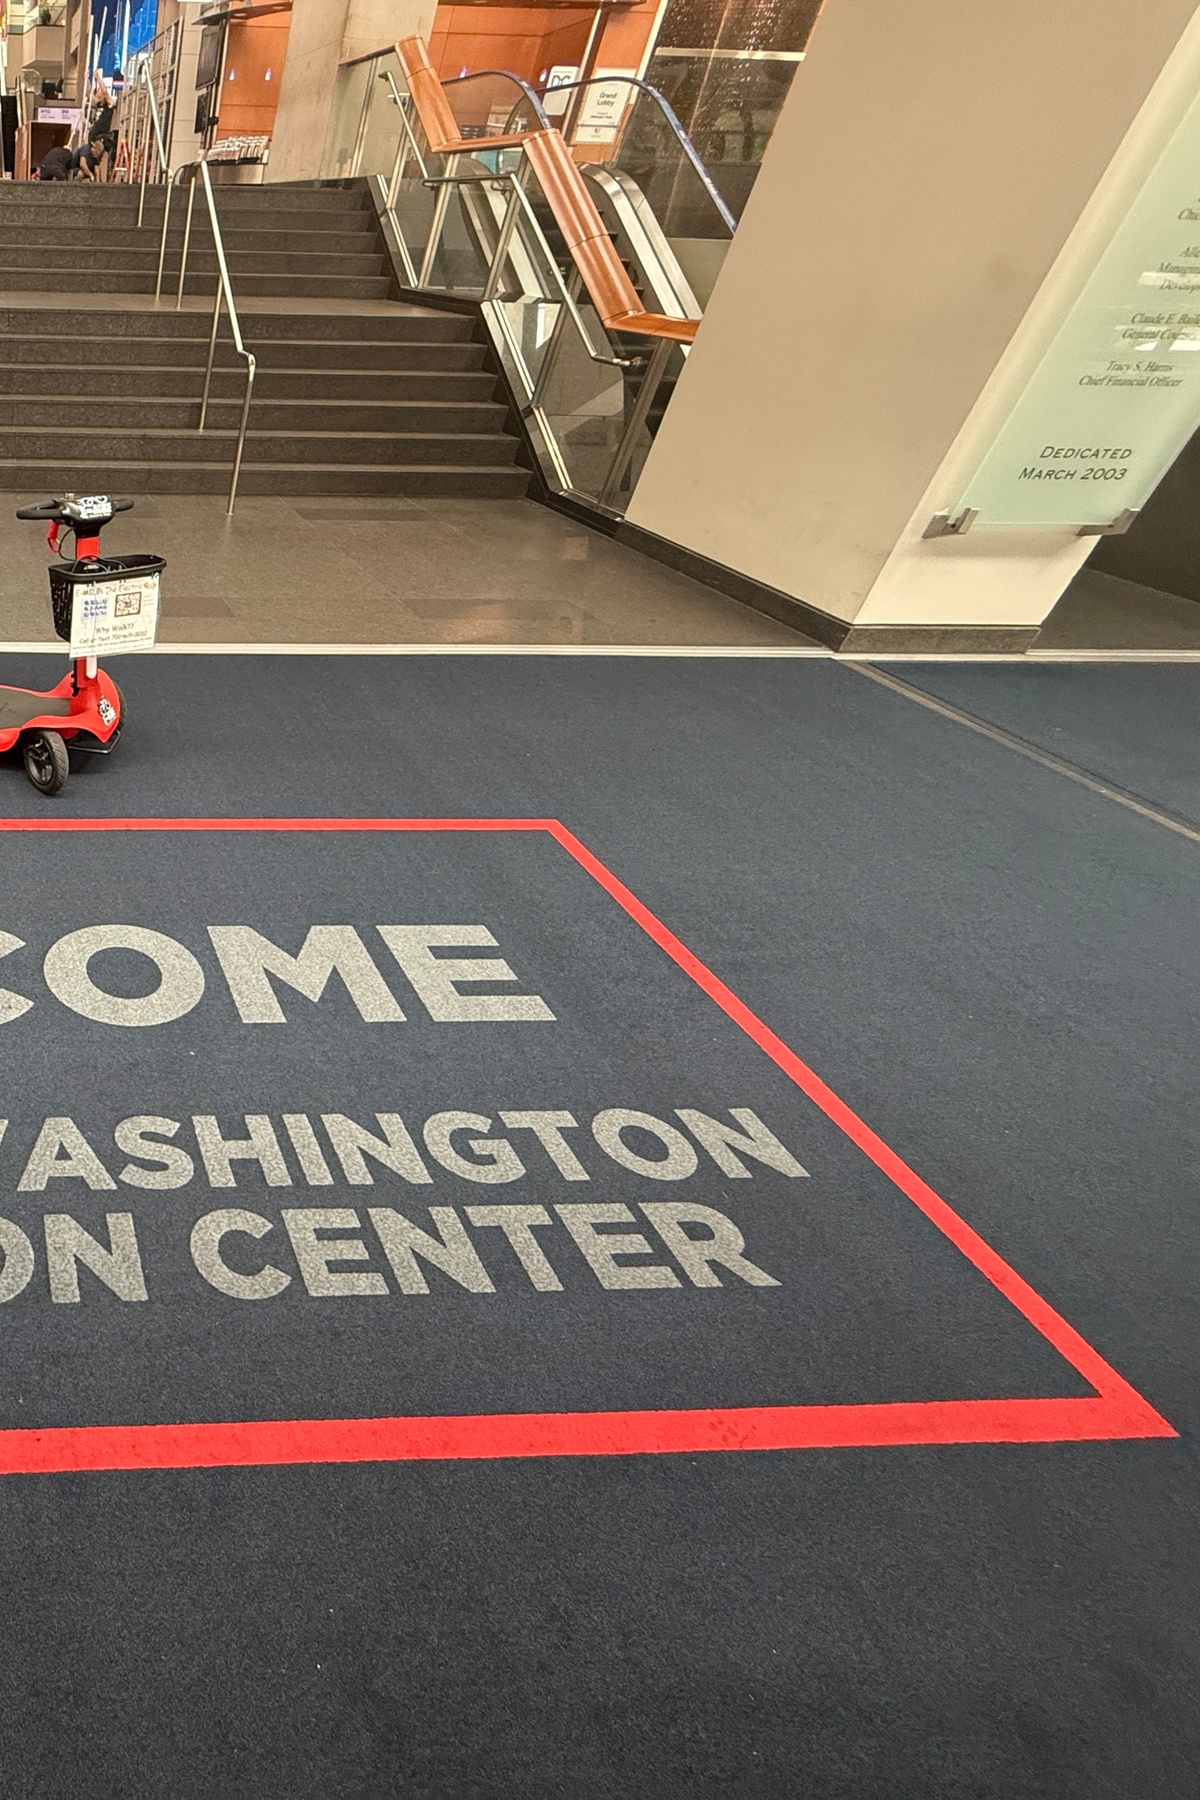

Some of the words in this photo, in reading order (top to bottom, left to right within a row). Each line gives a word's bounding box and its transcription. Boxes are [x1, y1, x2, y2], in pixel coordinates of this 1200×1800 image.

[1079, 375, 1109, 386] Chief
[1105, 376, 1148, 387] Financial
[1040, 446, 1132, 459] DEDICATED
[1018, 467, 1077, 480] MARCH
[1080, 467, 1128, 480] 2003
[190, 1201, 780, 1300] CENTER
